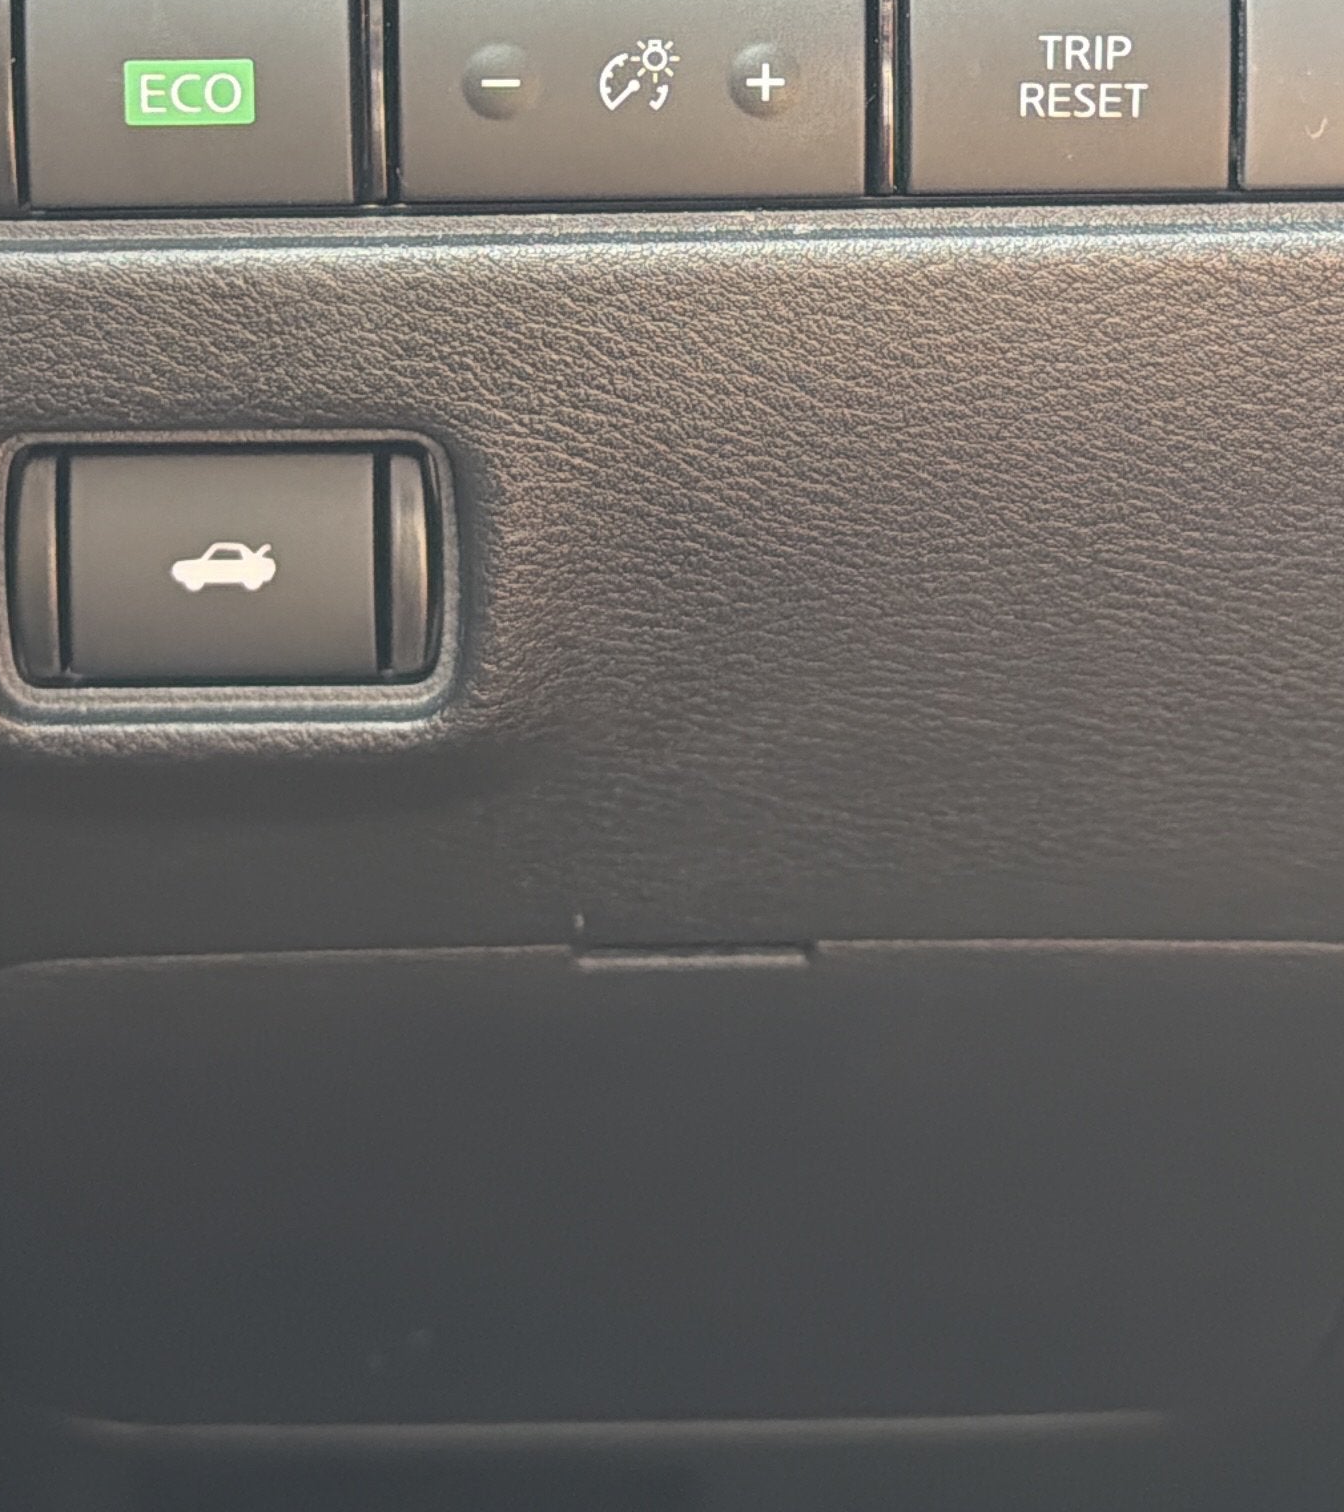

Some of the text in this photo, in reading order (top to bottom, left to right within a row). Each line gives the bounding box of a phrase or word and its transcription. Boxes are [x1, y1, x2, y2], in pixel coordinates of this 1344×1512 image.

[1038, 34, 1132, 71] TRIP
[139, 72, 242, 115] ECO
[1019, 82, 1149, 118] RESET
